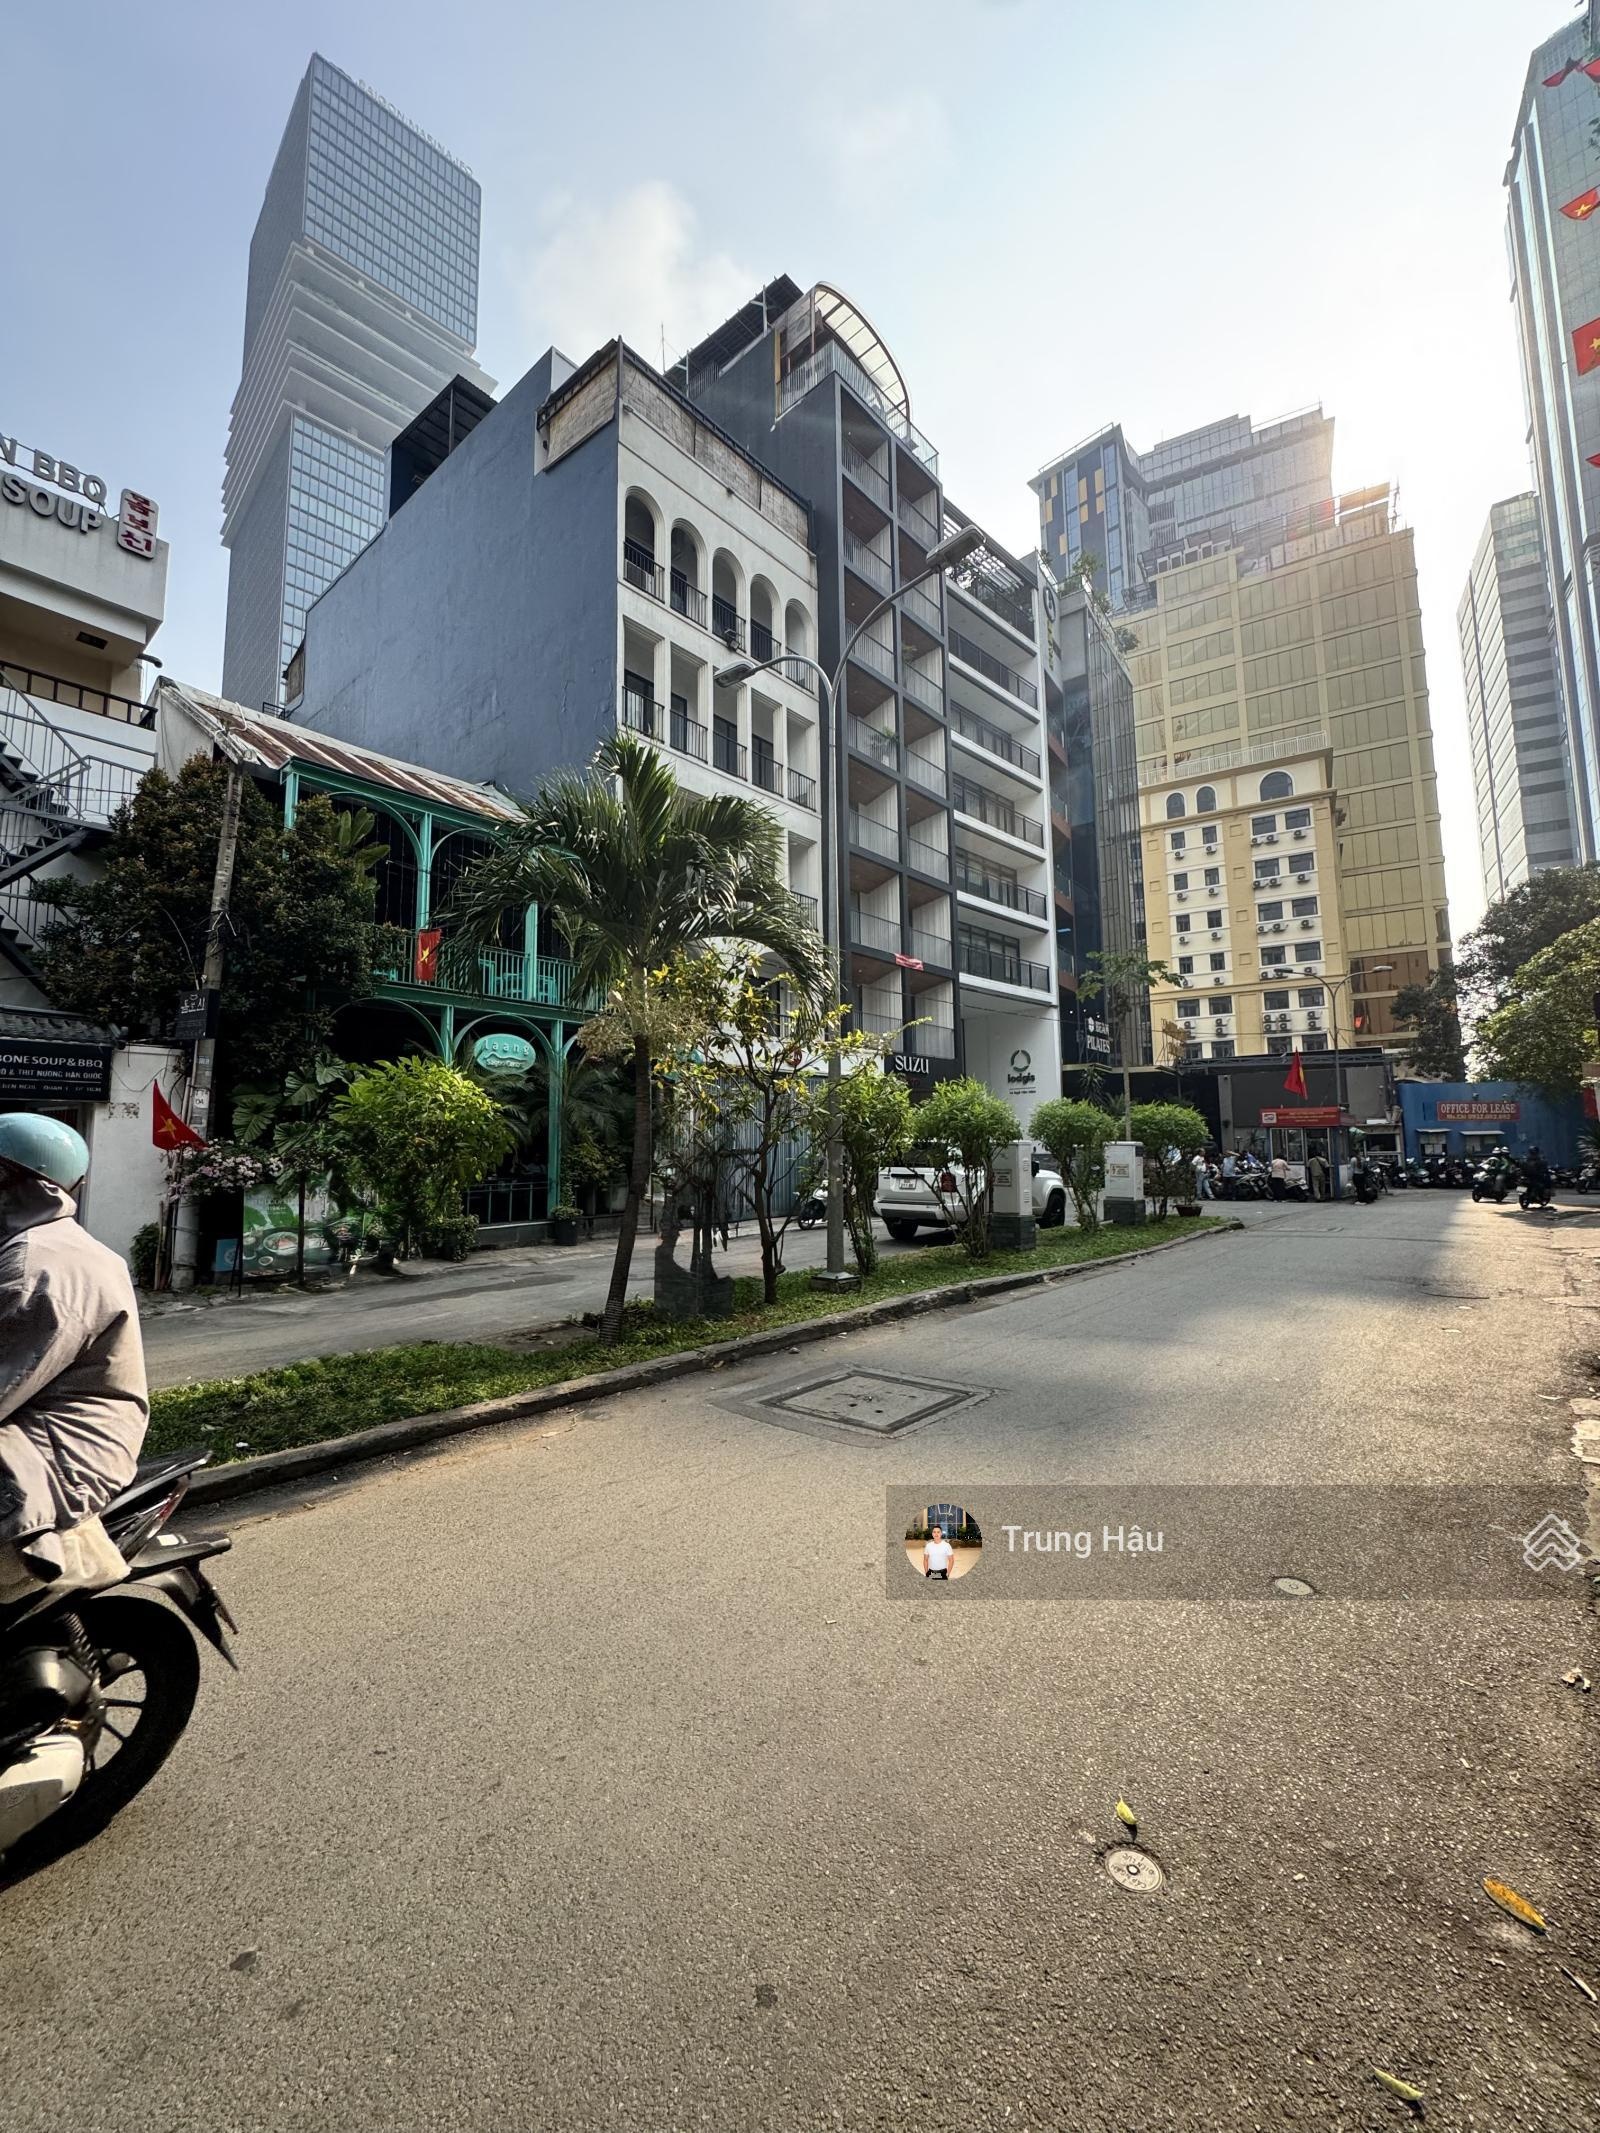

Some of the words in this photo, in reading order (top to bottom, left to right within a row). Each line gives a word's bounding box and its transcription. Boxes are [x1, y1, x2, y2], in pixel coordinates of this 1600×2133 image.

[33, 448, 107, 506] BBQ
[2, 473, 103, 535] SOUP
[485, 1039, 530, 1056] laang
[1087, 1034, 1111, 1053] PILATES
[1008, 1072, 1035, 1085] lodgis
[1441, 1103, 1469, 1113] OFFICE
[1472, 1103, 1488, 1113] FOR
[1490, 1103, 1516, 1113] LEASE
